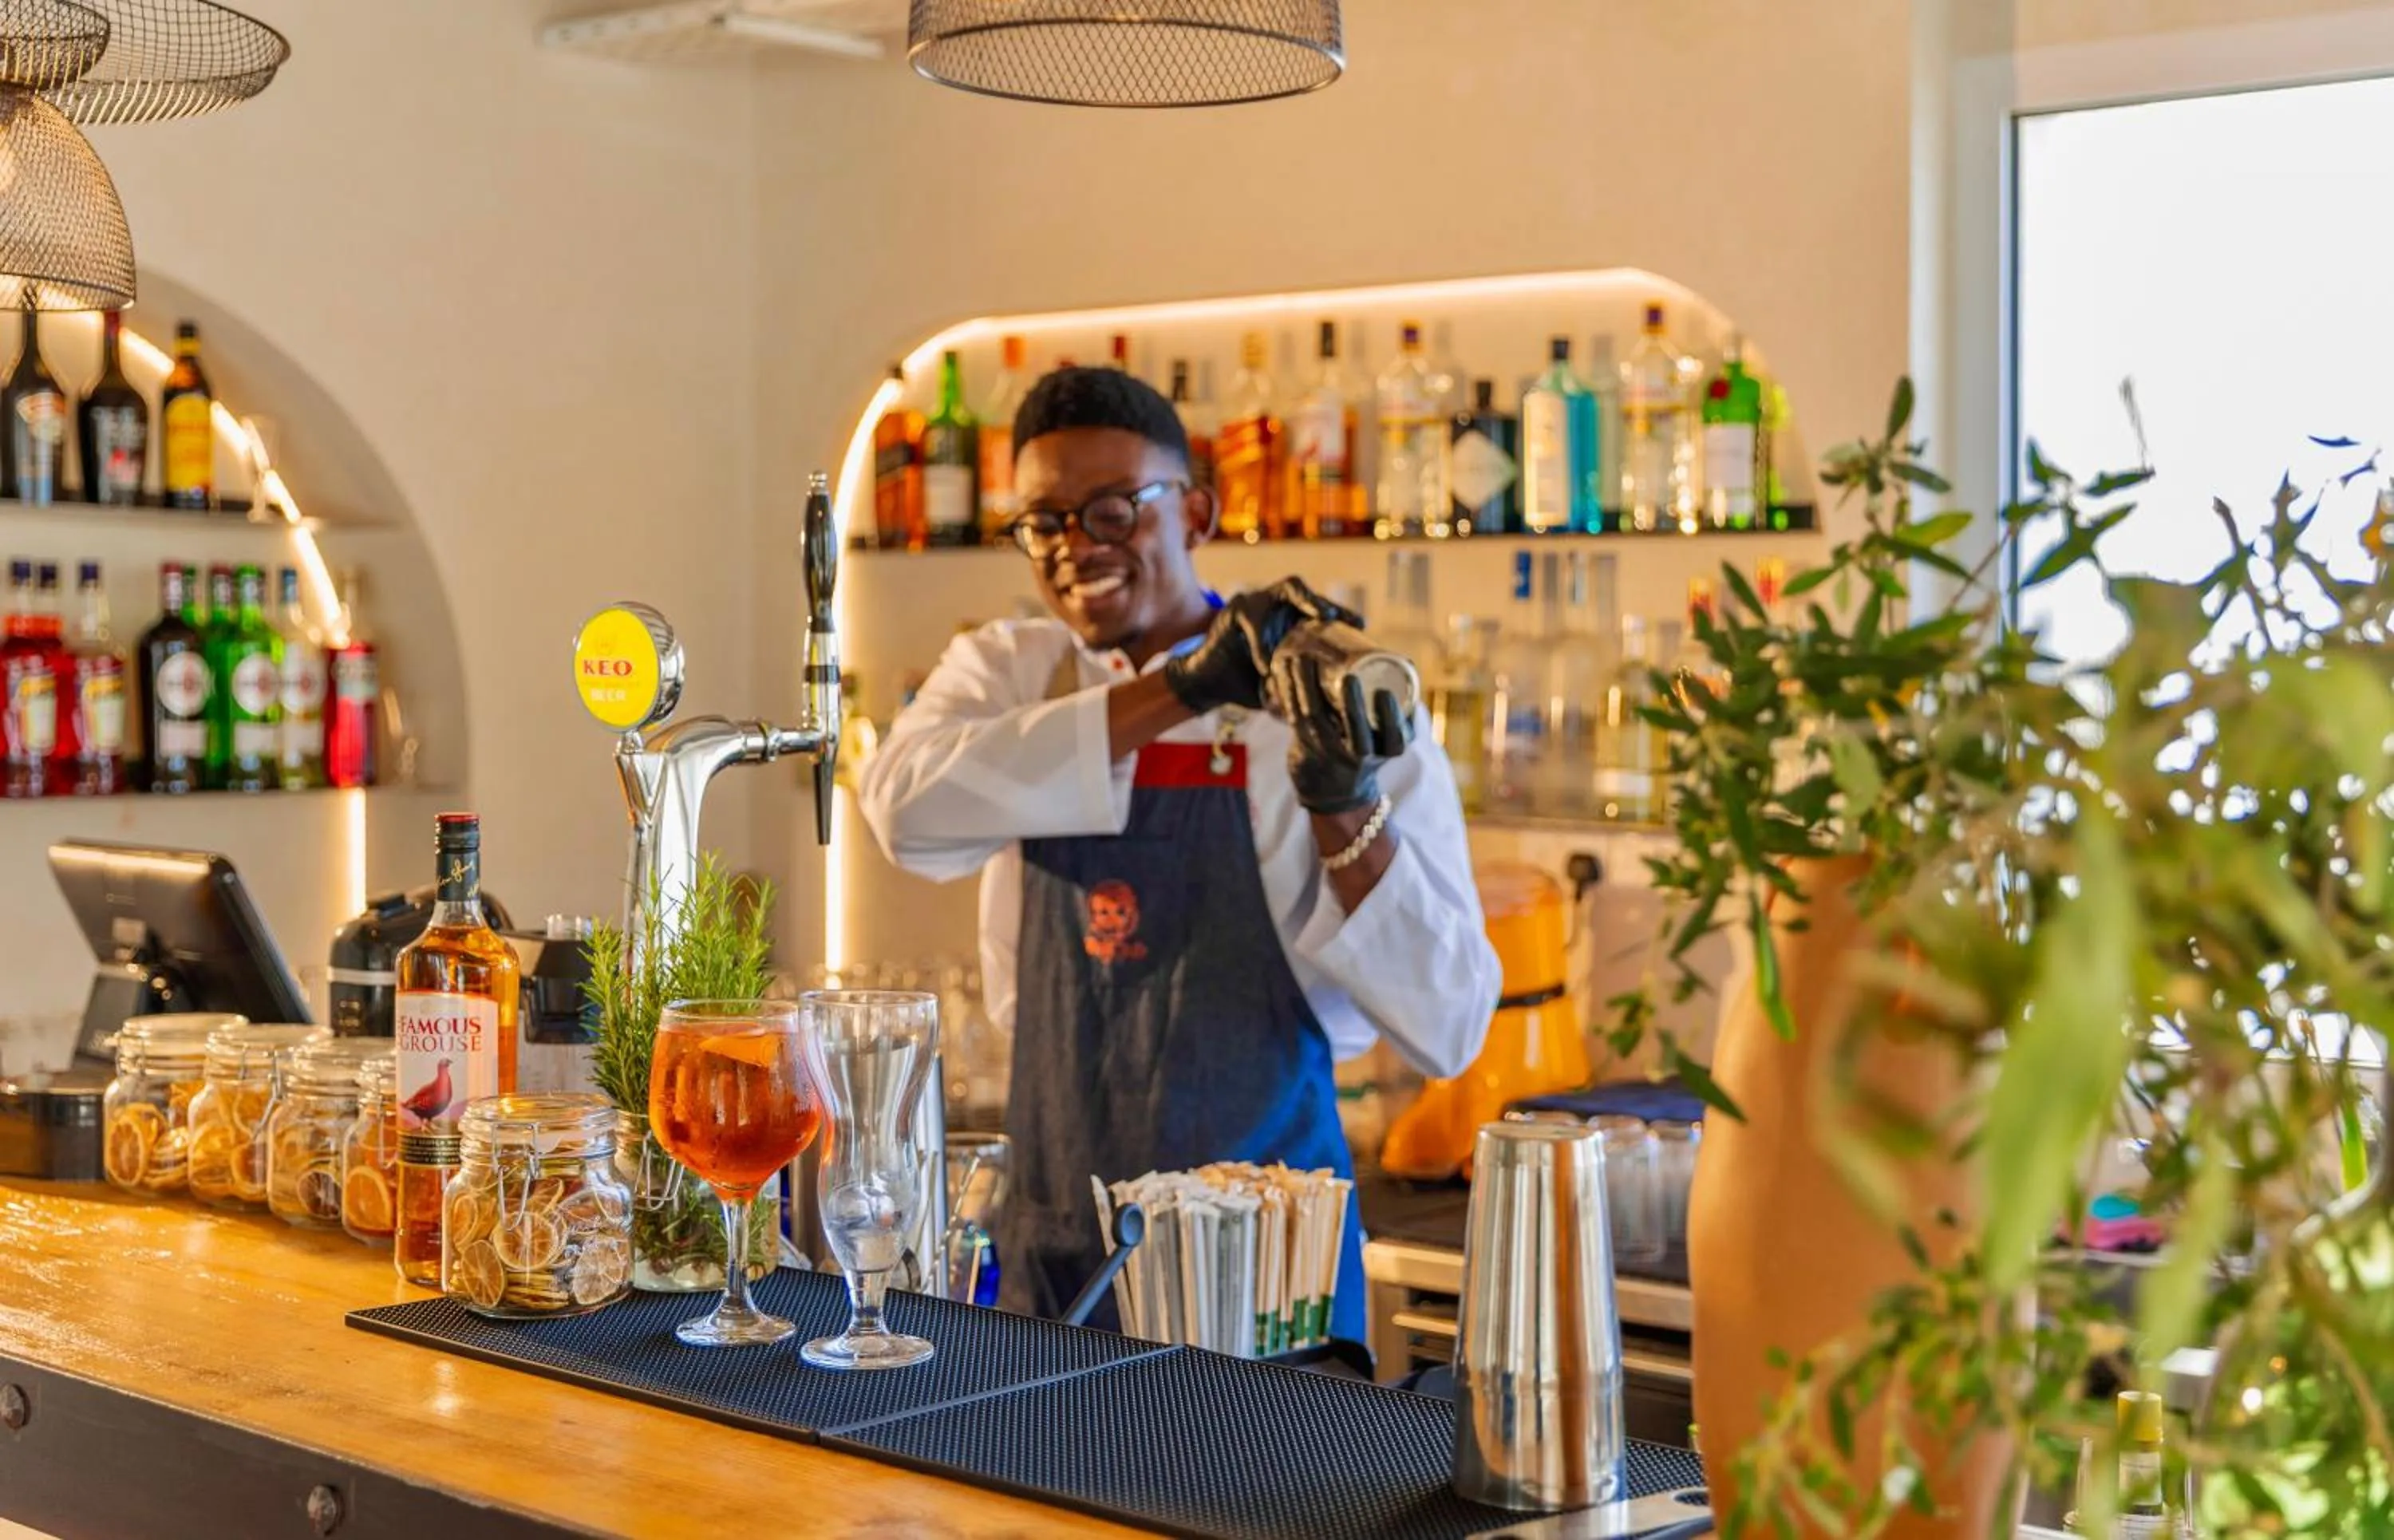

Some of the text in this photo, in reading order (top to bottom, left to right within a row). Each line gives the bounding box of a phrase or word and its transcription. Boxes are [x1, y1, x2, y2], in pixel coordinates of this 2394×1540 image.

[583, 659, 633, 677] KEO
[591, 688, 626, 702] BEER
[400, 1016, 482, 1035] FAMOUS
[400, 1035, 482, 1052] GROUSE
